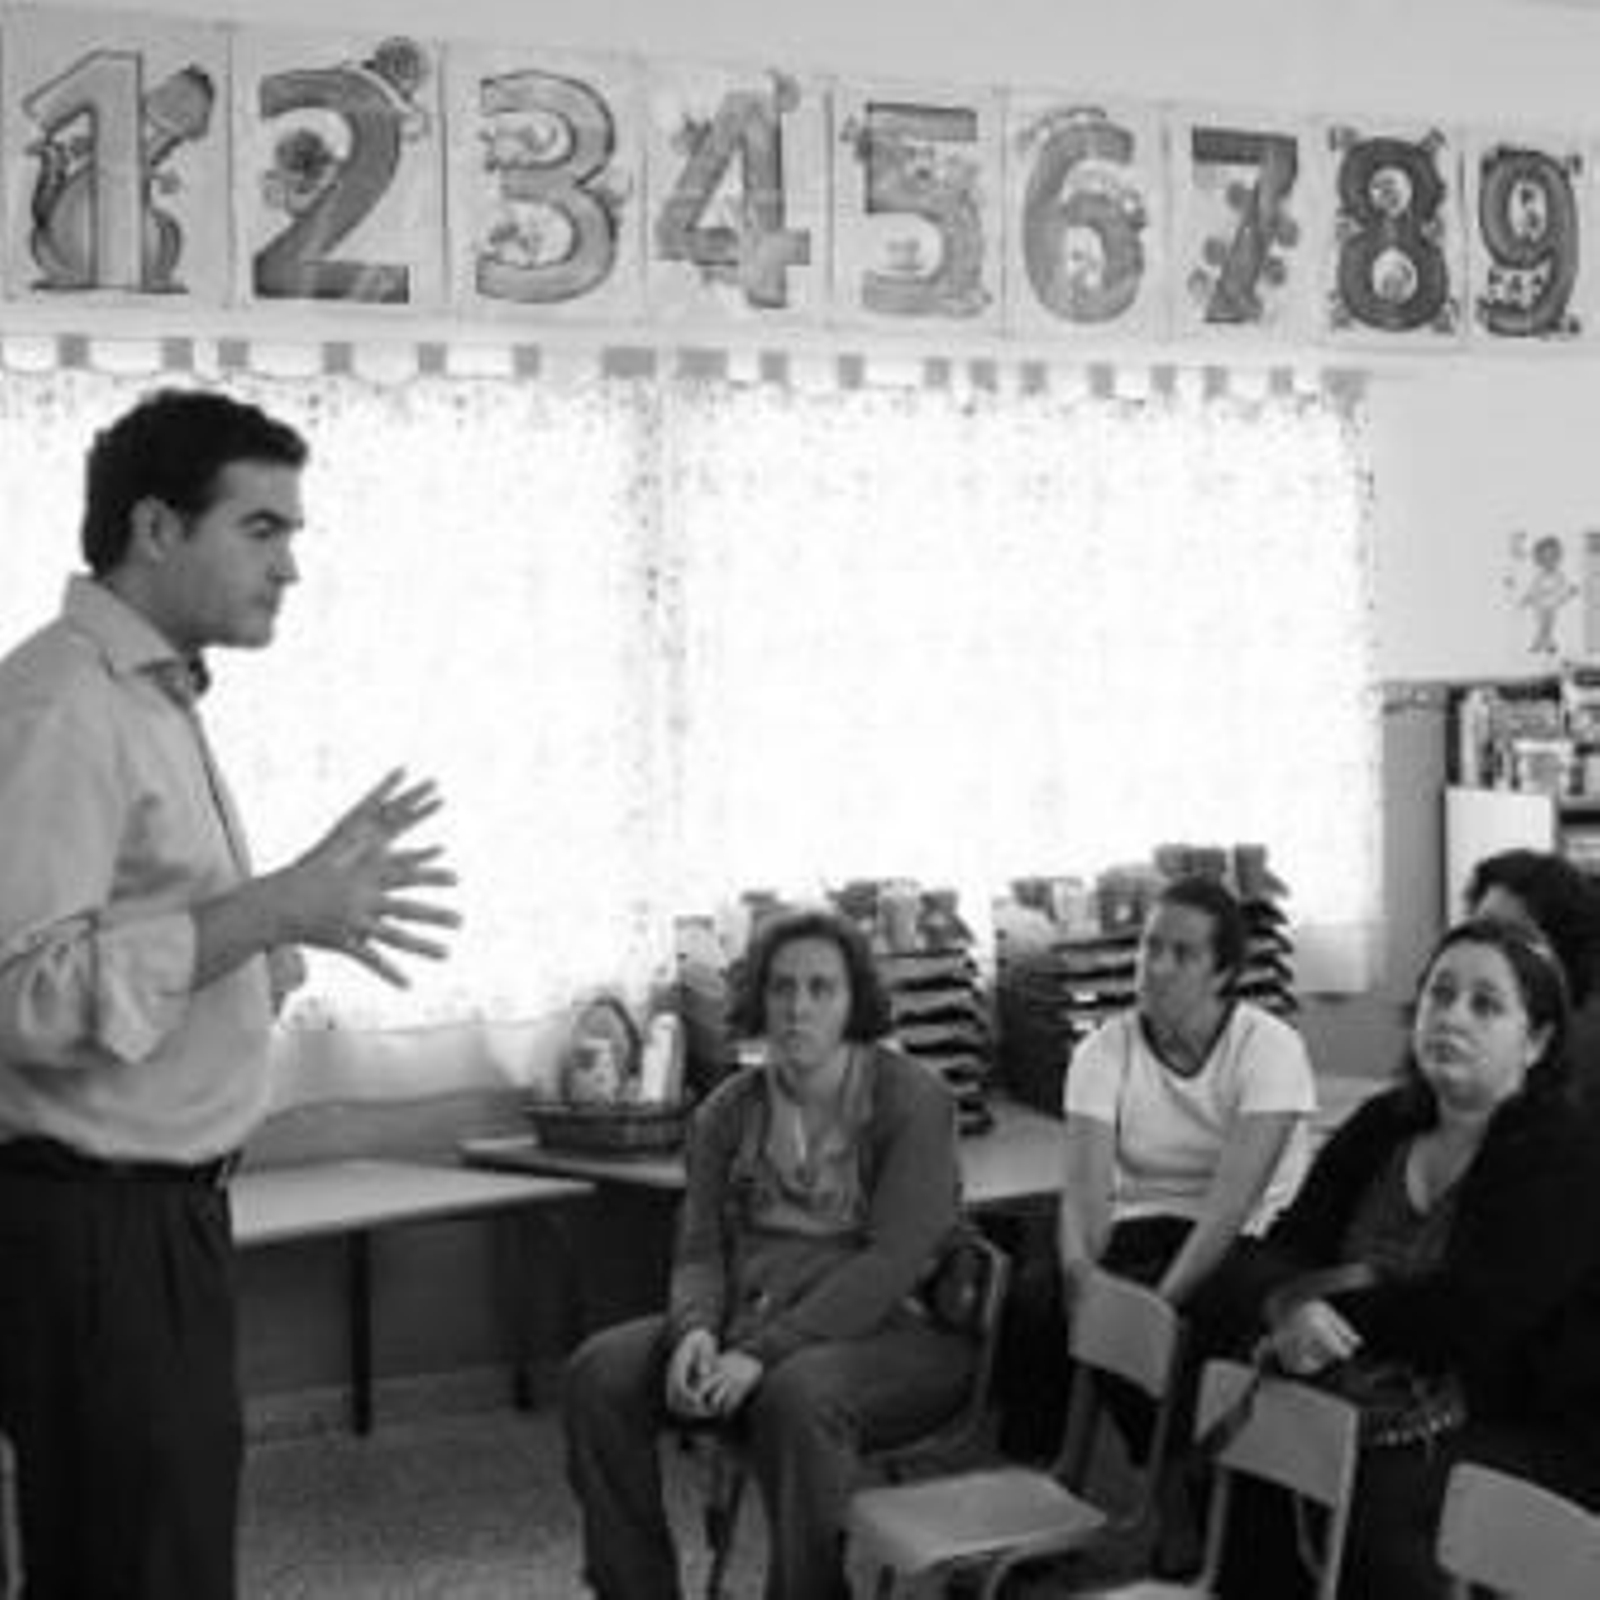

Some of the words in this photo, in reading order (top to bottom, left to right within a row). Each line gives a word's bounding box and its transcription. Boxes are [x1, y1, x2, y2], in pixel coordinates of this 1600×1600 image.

[22, 49, 148, 292] 1
[252, 68, 410, 304] 2
[475, 69, 620, 304] 3
[658, 90, 811, 308] 4
[862, 101, 988, 316] 5
[1023, 118, 1146, 324] 6
[1191, 127, 1299, 323] 7
[1337, 138, 1450, 331] 8
[1478, 148, 1579, 337] 9
